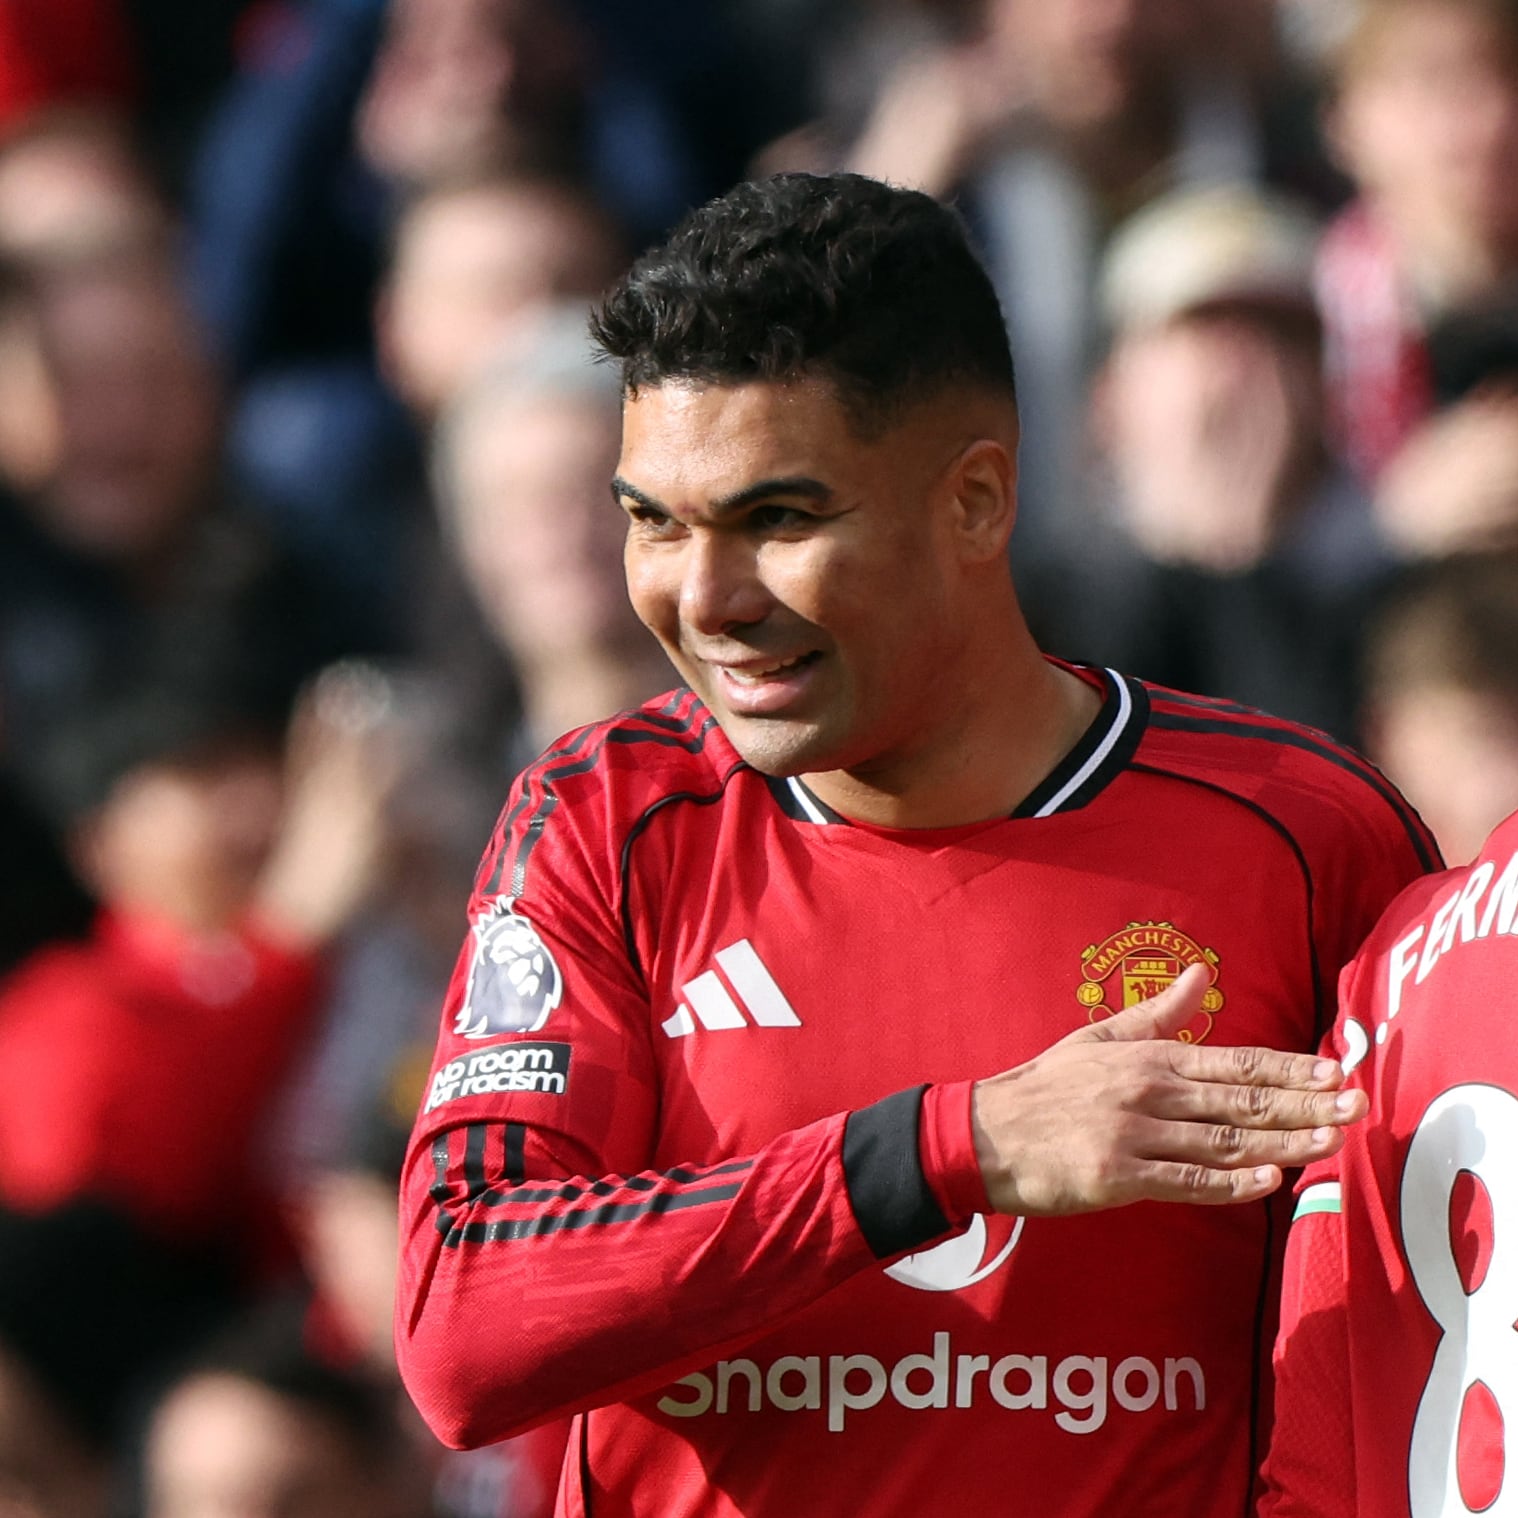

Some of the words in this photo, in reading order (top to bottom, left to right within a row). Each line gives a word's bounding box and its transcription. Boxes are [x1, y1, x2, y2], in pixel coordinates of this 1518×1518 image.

[1091, 931, 1201, 973] MANCHESTE
[431, 1061, 466, 1090] No
[467, 1048, 554, 1077] room
[423, 1080, 461, 1115] for
[460, 1070, 565, 1095] racism
